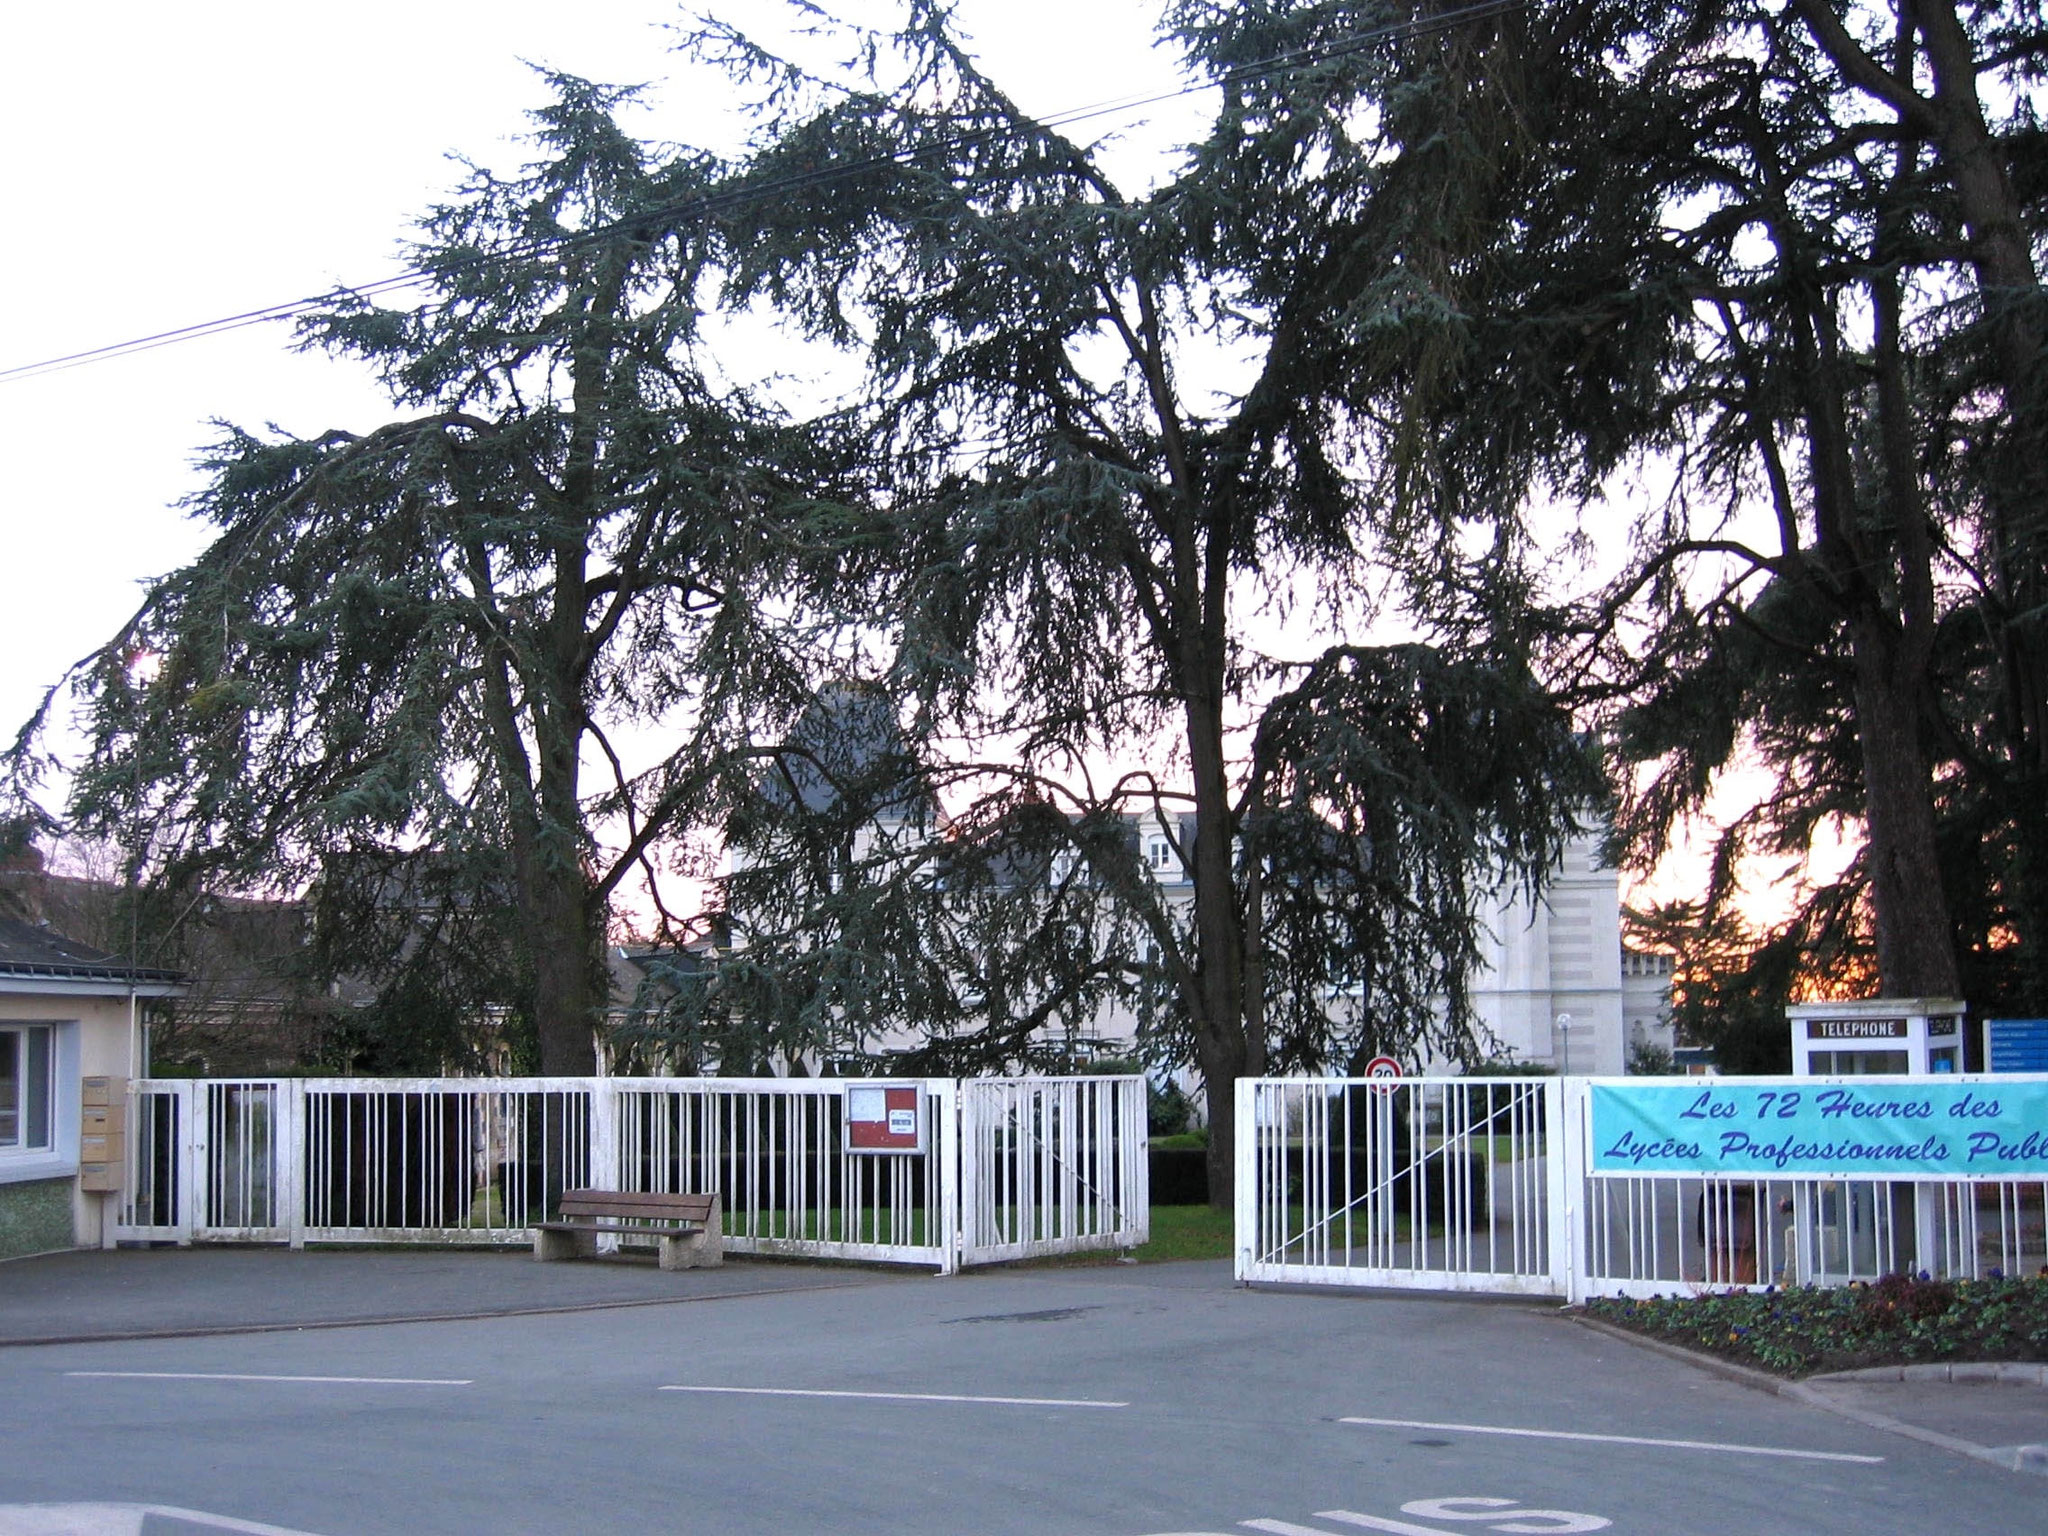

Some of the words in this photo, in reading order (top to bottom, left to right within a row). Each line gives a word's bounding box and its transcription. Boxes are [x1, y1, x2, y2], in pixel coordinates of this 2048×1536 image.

[1820, 1021, 1896, 1037] TELEPHONE
[1679, 1090, 1739, 1120] Les
[1757, 1091, 1801, 1120] 72
[1815, 1089, 1934, 1120] Heures
[1948, 1092, 2003, 1119] des
[1603, 1130, 1703, 1166] Lycées
[1718, 1131, 1951, 1169] Professionnels
